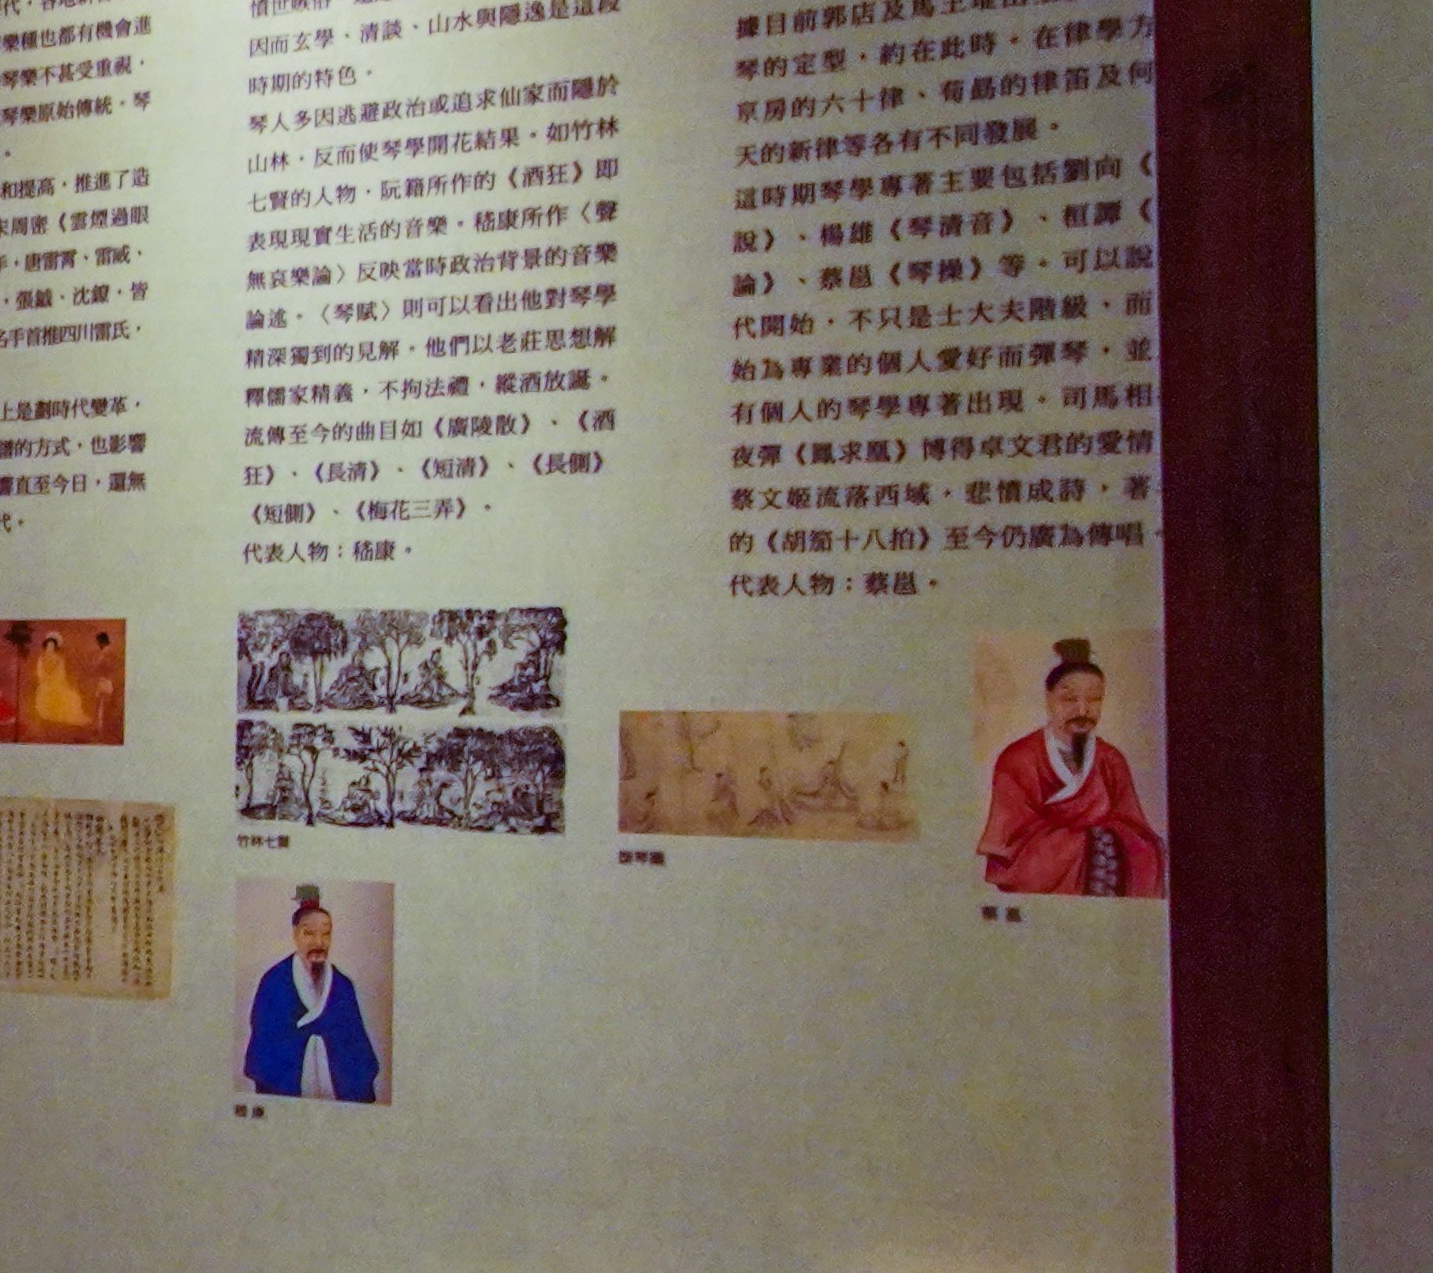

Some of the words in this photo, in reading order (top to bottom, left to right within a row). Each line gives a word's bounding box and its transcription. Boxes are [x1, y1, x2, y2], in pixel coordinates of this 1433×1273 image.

[247, 57, 373, 97] 時期的特色。
[727, 565, 938, 598] 代表人物：蔡邕。
